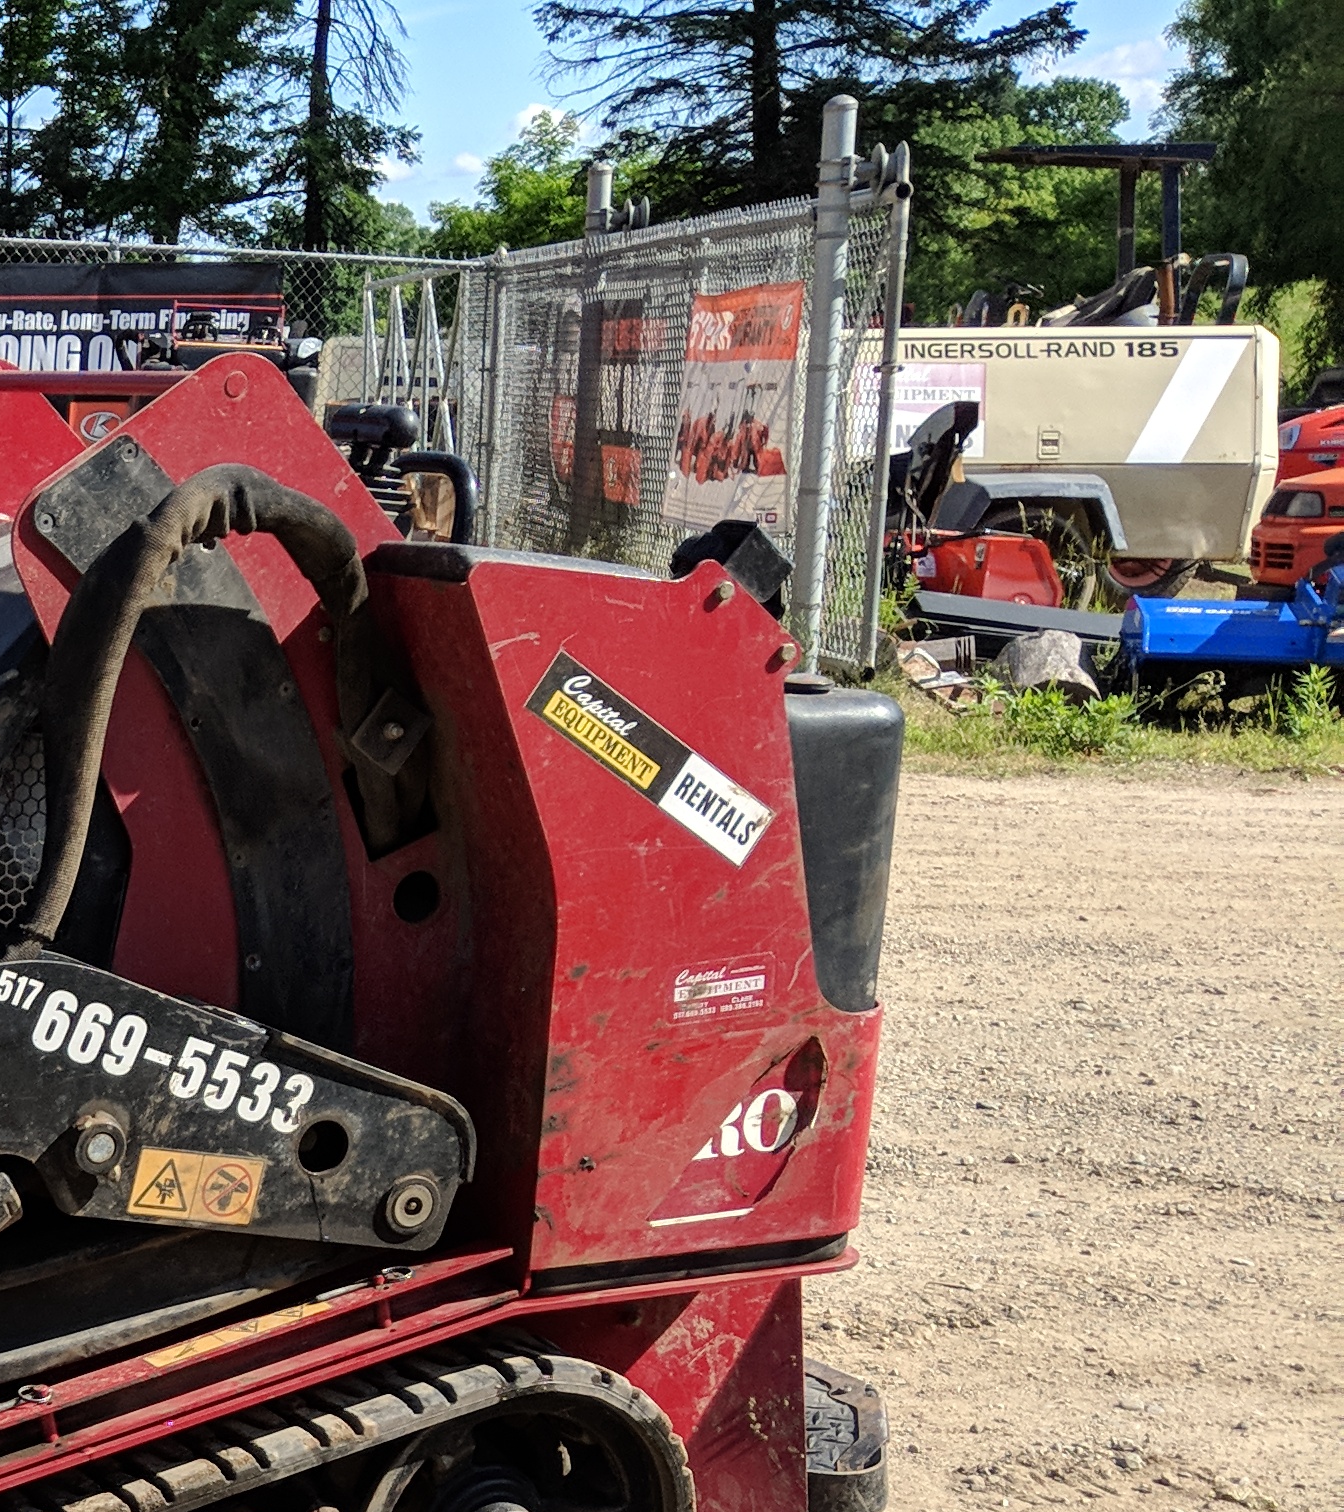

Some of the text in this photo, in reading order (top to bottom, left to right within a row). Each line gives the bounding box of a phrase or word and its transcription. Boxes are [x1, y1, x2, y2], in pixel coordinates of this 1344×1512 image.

[62, 309, 155, 333] Long-Term
[904, 341, 1179, 360] INGERSOLL-RAND 185
[563, 674, 639, 736] Capital
[550, 696, 653, 782] EQUIPMENT
[673, 772, 757, 847] RENTALS
[674, 966, 727, 986] Capital
[678, 978, 762, 999] EIPMENT
[31, 989, 314, 1134] 669-5533
